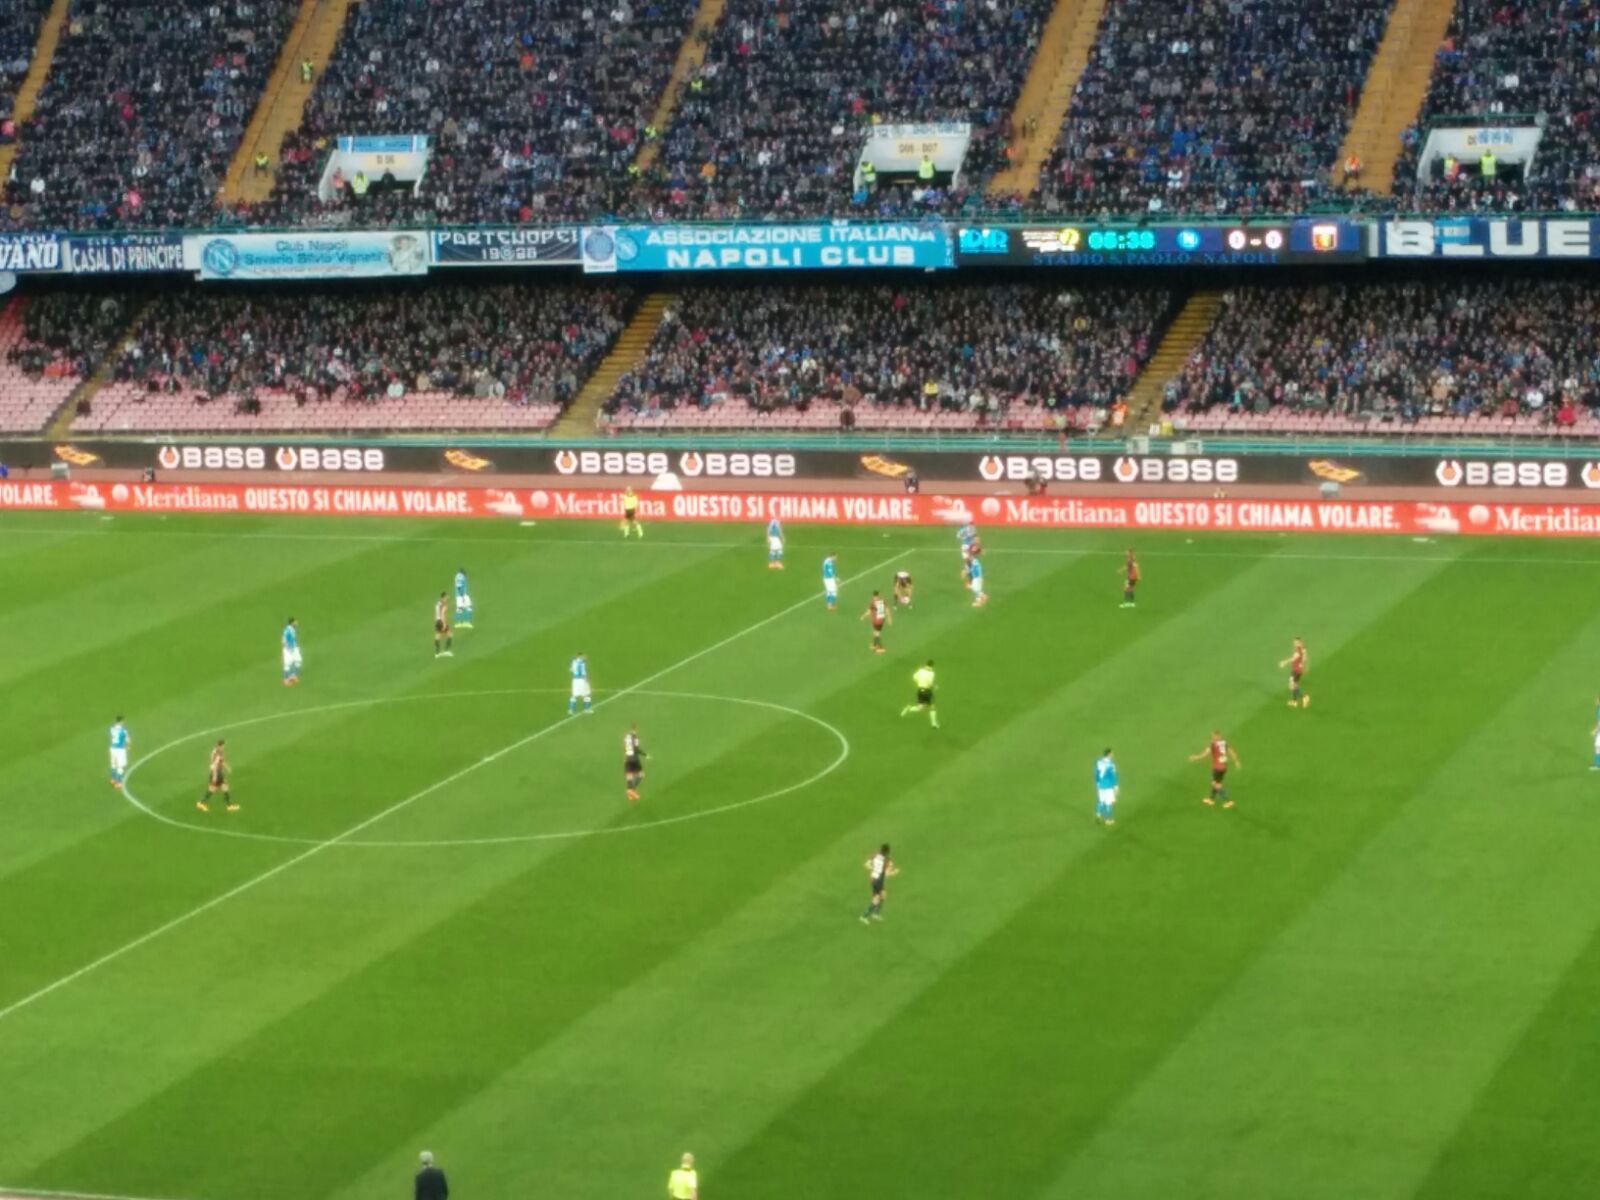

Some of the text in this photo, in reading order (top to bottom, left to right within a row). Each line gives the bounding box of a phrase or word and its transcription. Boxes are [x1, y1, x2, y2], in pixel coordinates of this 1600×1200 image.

[276, 240, 304, 251] Club
[646, 226, 936, 245] ASSOCIAZIONE ITALIANA
[72, 244, 183, 273] CASAL DI PRINCIPE
[666, 246, 915, 269] NAPOLI CLUB
[1033, 252, 1103, 266] STADIO
[1127, 252, 1191, 265] PAOLO
[1203, 251, 1278, 264] NAPOLI
[133, 485, 473, 513] Meridiana QUESTO SI CHIAMA VOLARE.
[554, 492, 919, 520] Meridina QUESTO SI CHIAMA VOLARE.
[1006, 499, 1401, 529] Meridiana QUESTO SI CHIAMA VOLARE.
